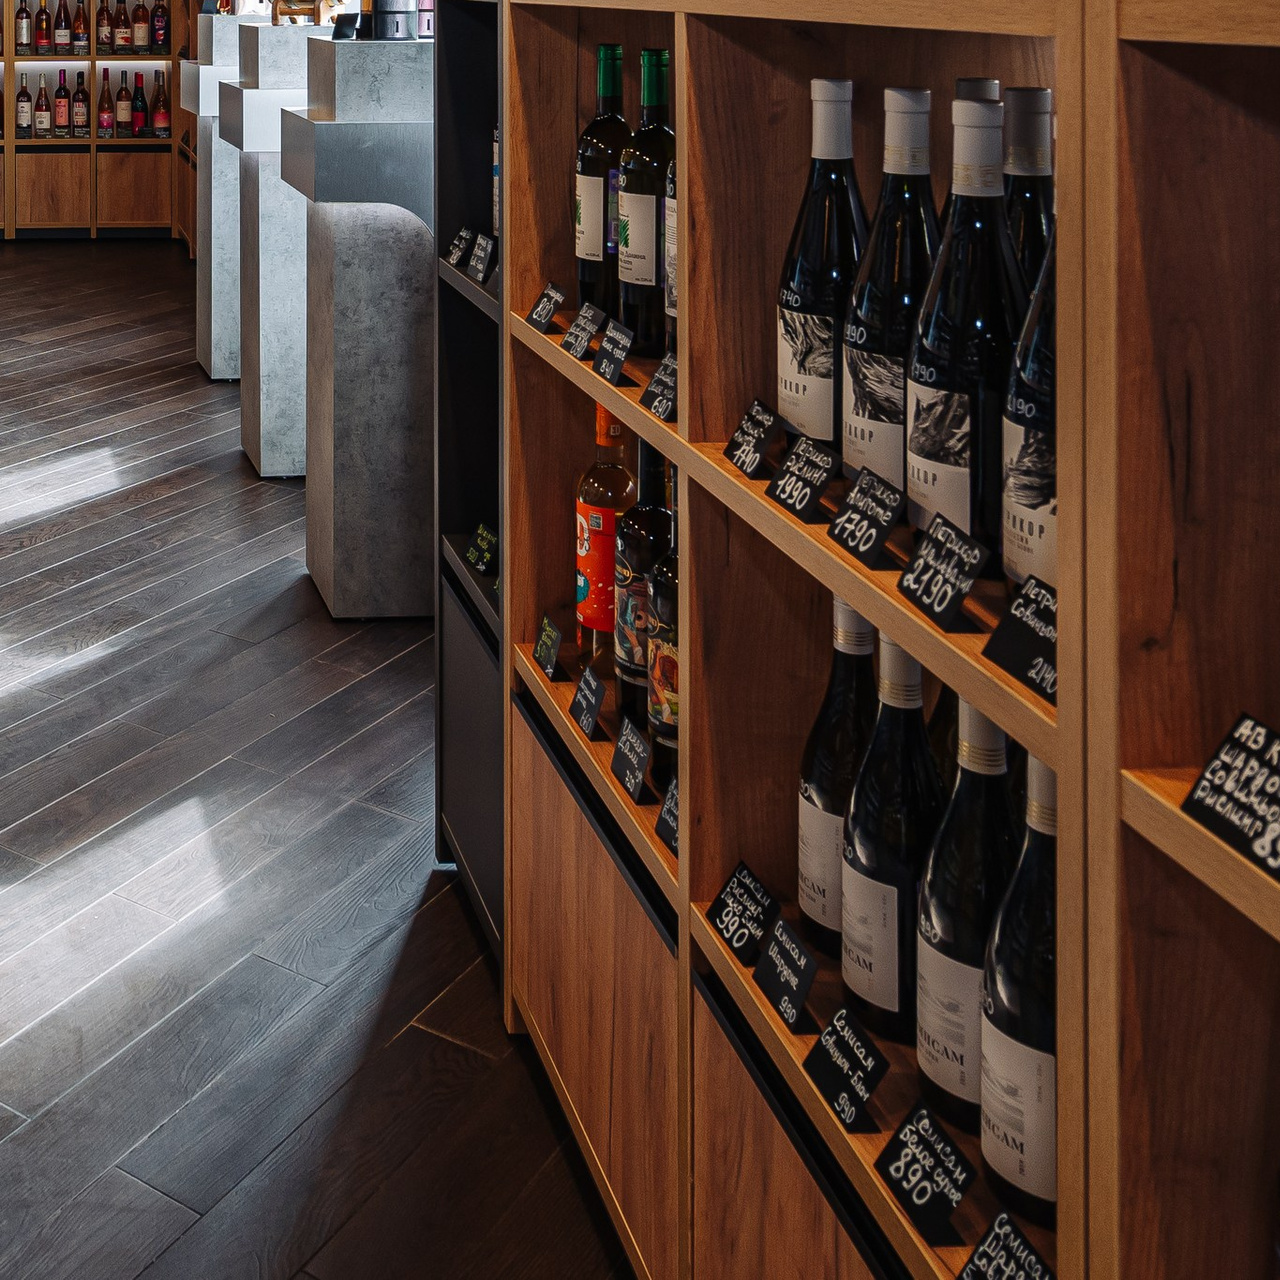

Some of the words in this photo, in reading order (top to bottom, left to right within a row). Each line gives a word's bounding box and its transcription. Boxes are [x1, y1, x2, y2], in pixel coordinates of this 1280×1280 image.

[651, 396, 672, 419] 690
[776, 473, 811, 510] 1990
[835, 510, 877, 552] 1790
[903, 557, 953, 612] 2190
[1021, 579, 1057, 613] Петри
[1204, 759, 1280, 822] Совиньо
[716, 907, 749, 948] 990
[768, 941, 799, 991] Шардоне
[778, 996, 797, 1023] 990
[833, 1009, 875, 1072] Семисам
[833, 1092, 856, 1124] 990
[913, 1109, 967, 1186] Семисам
[888, 1148, 932, 1206] 890
